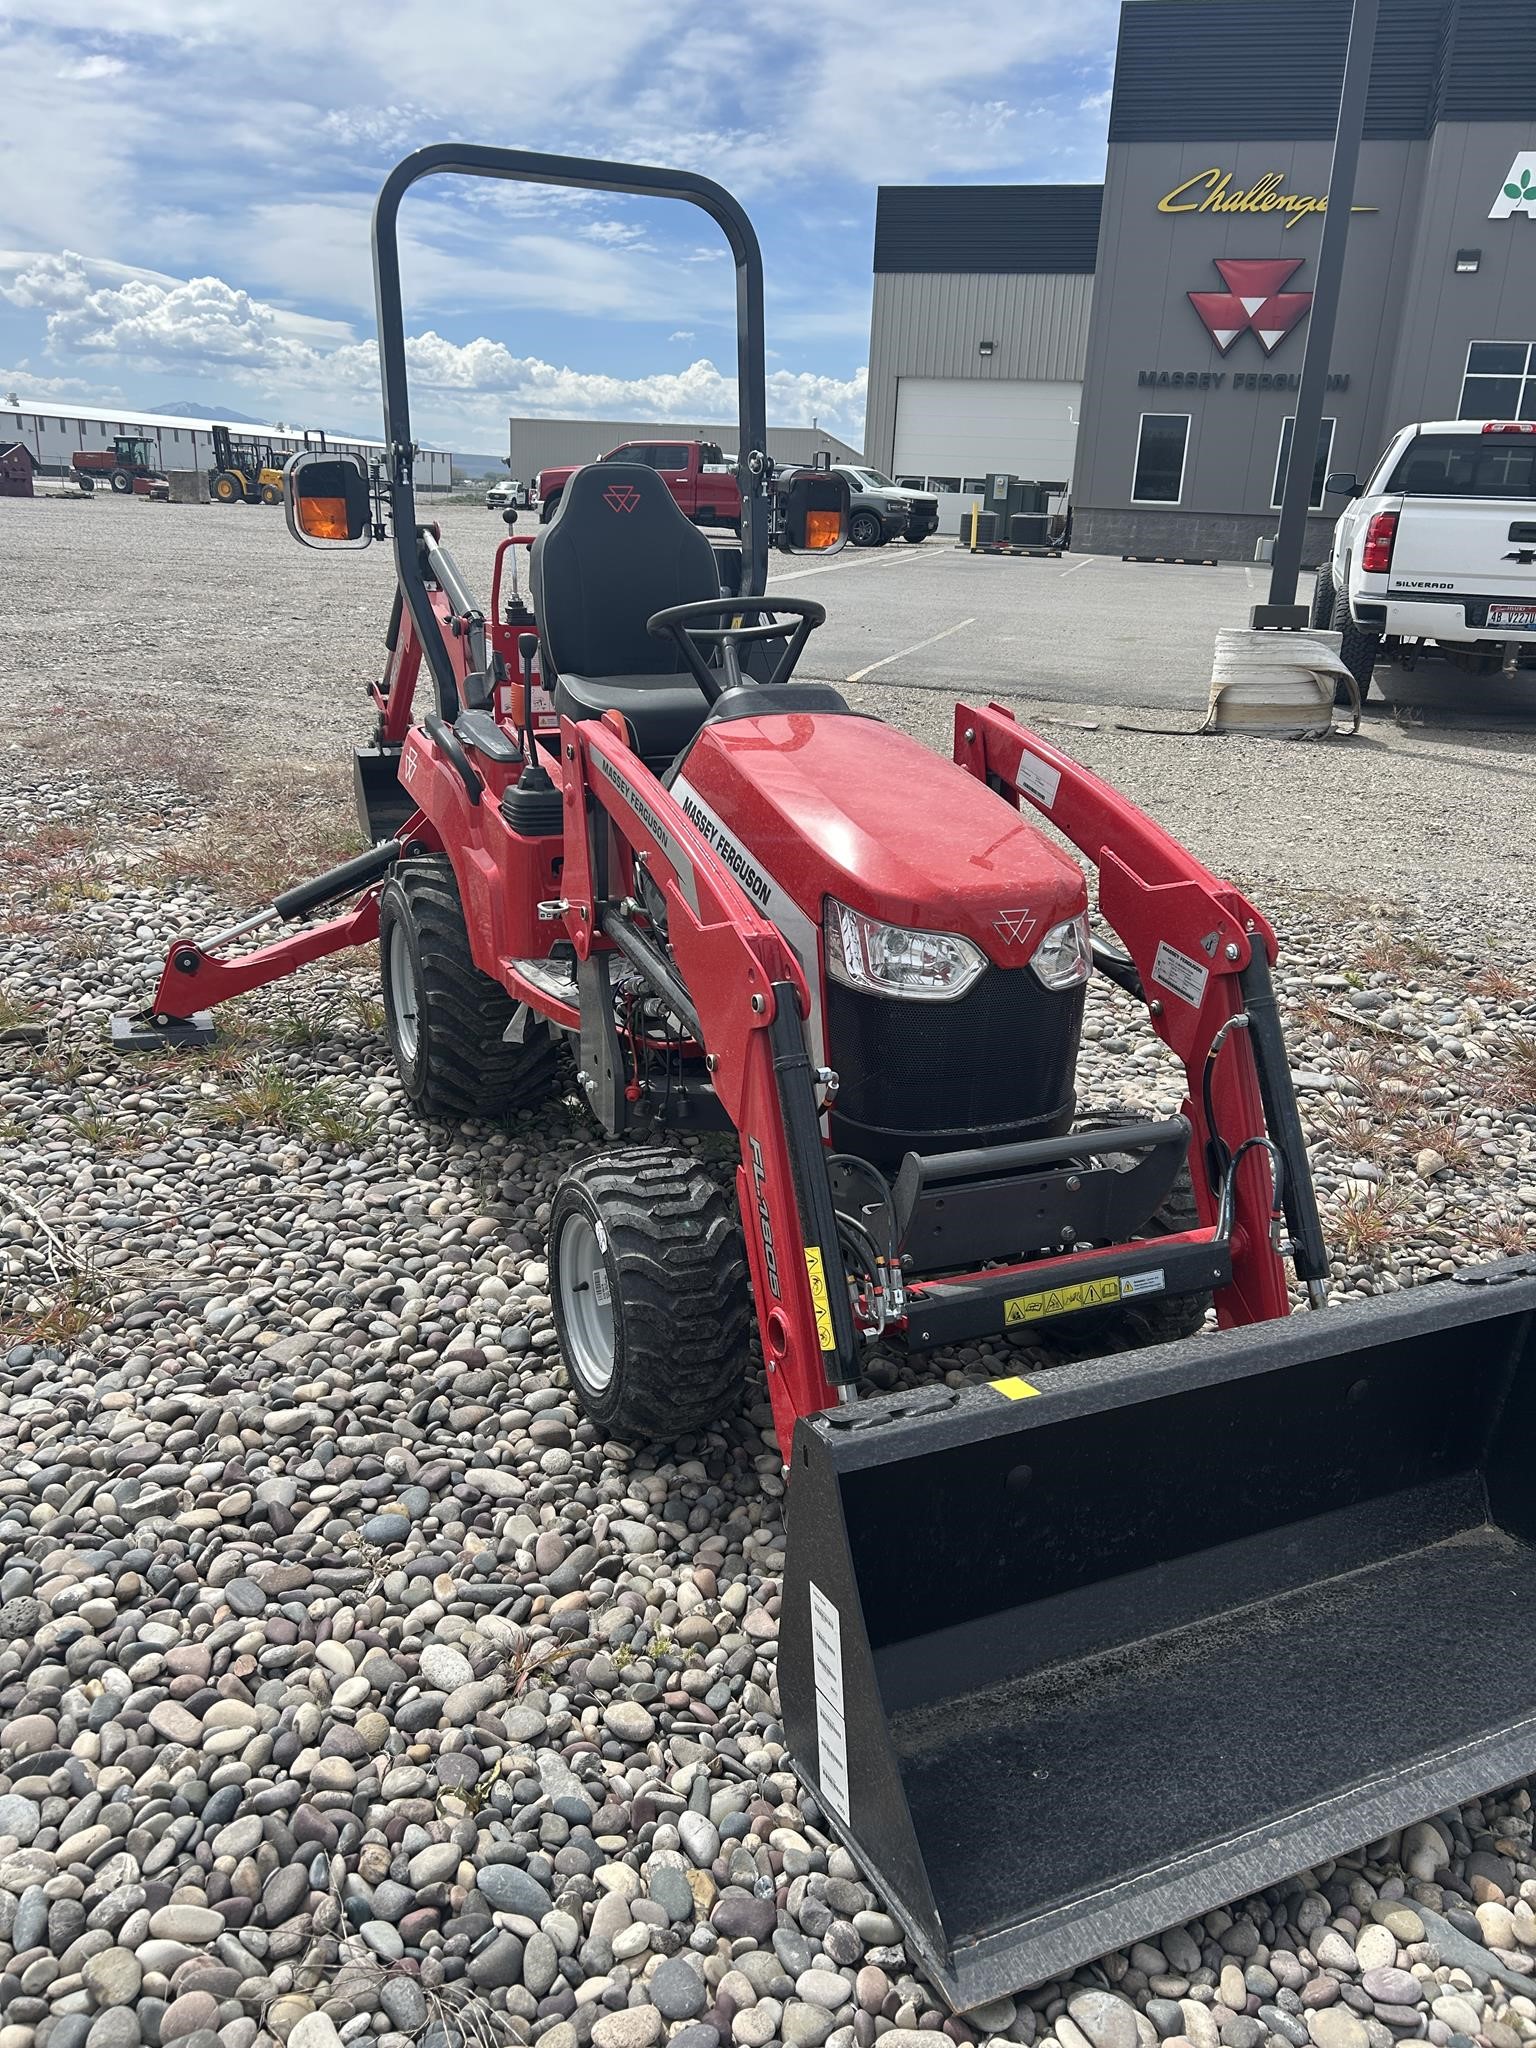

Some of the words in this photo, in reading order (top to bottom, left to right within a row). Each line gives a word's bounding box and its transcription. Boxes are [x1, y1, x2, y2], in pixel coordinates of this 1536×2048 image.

[1157, 167, 1379, 229] Challenge
[1138, 371, 1225, 390] MASSEY
[1396, 581, 1454, 589] SILVERADO
[602, 759, 630, 797] MASSEY
[630, 792, 669, 848] FERGUSON
[682, 796, 718, 843] MASSEY
[716, 835, 771, 906] FERGUSON
